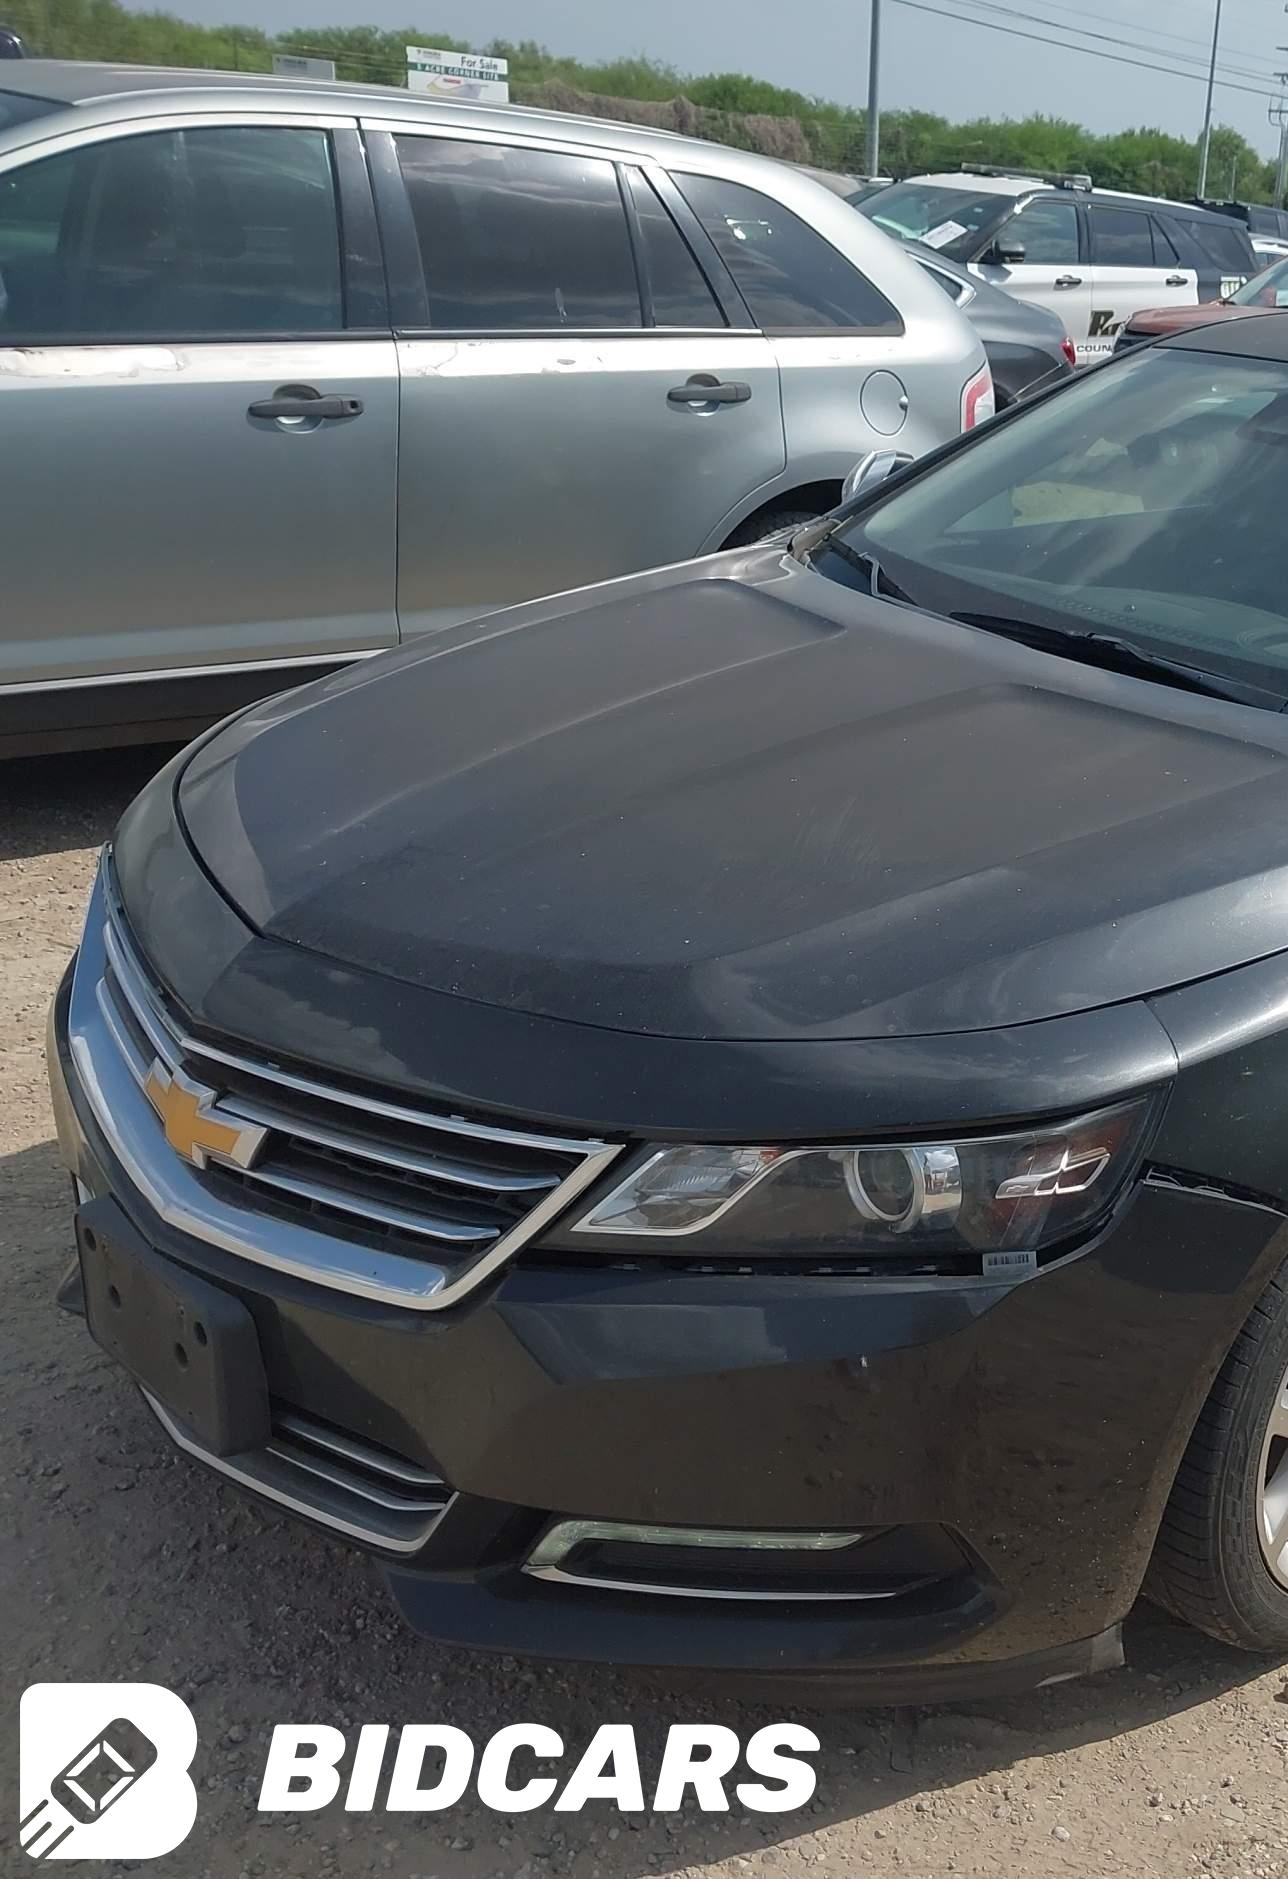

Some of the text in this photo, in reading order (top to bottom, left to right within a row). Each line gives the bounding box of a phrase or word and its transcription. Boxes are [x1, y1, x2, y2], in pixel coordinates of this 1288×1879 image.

[460, 56, 498, 71] For Sale
[1076, 344, 1112, 353] COUN
